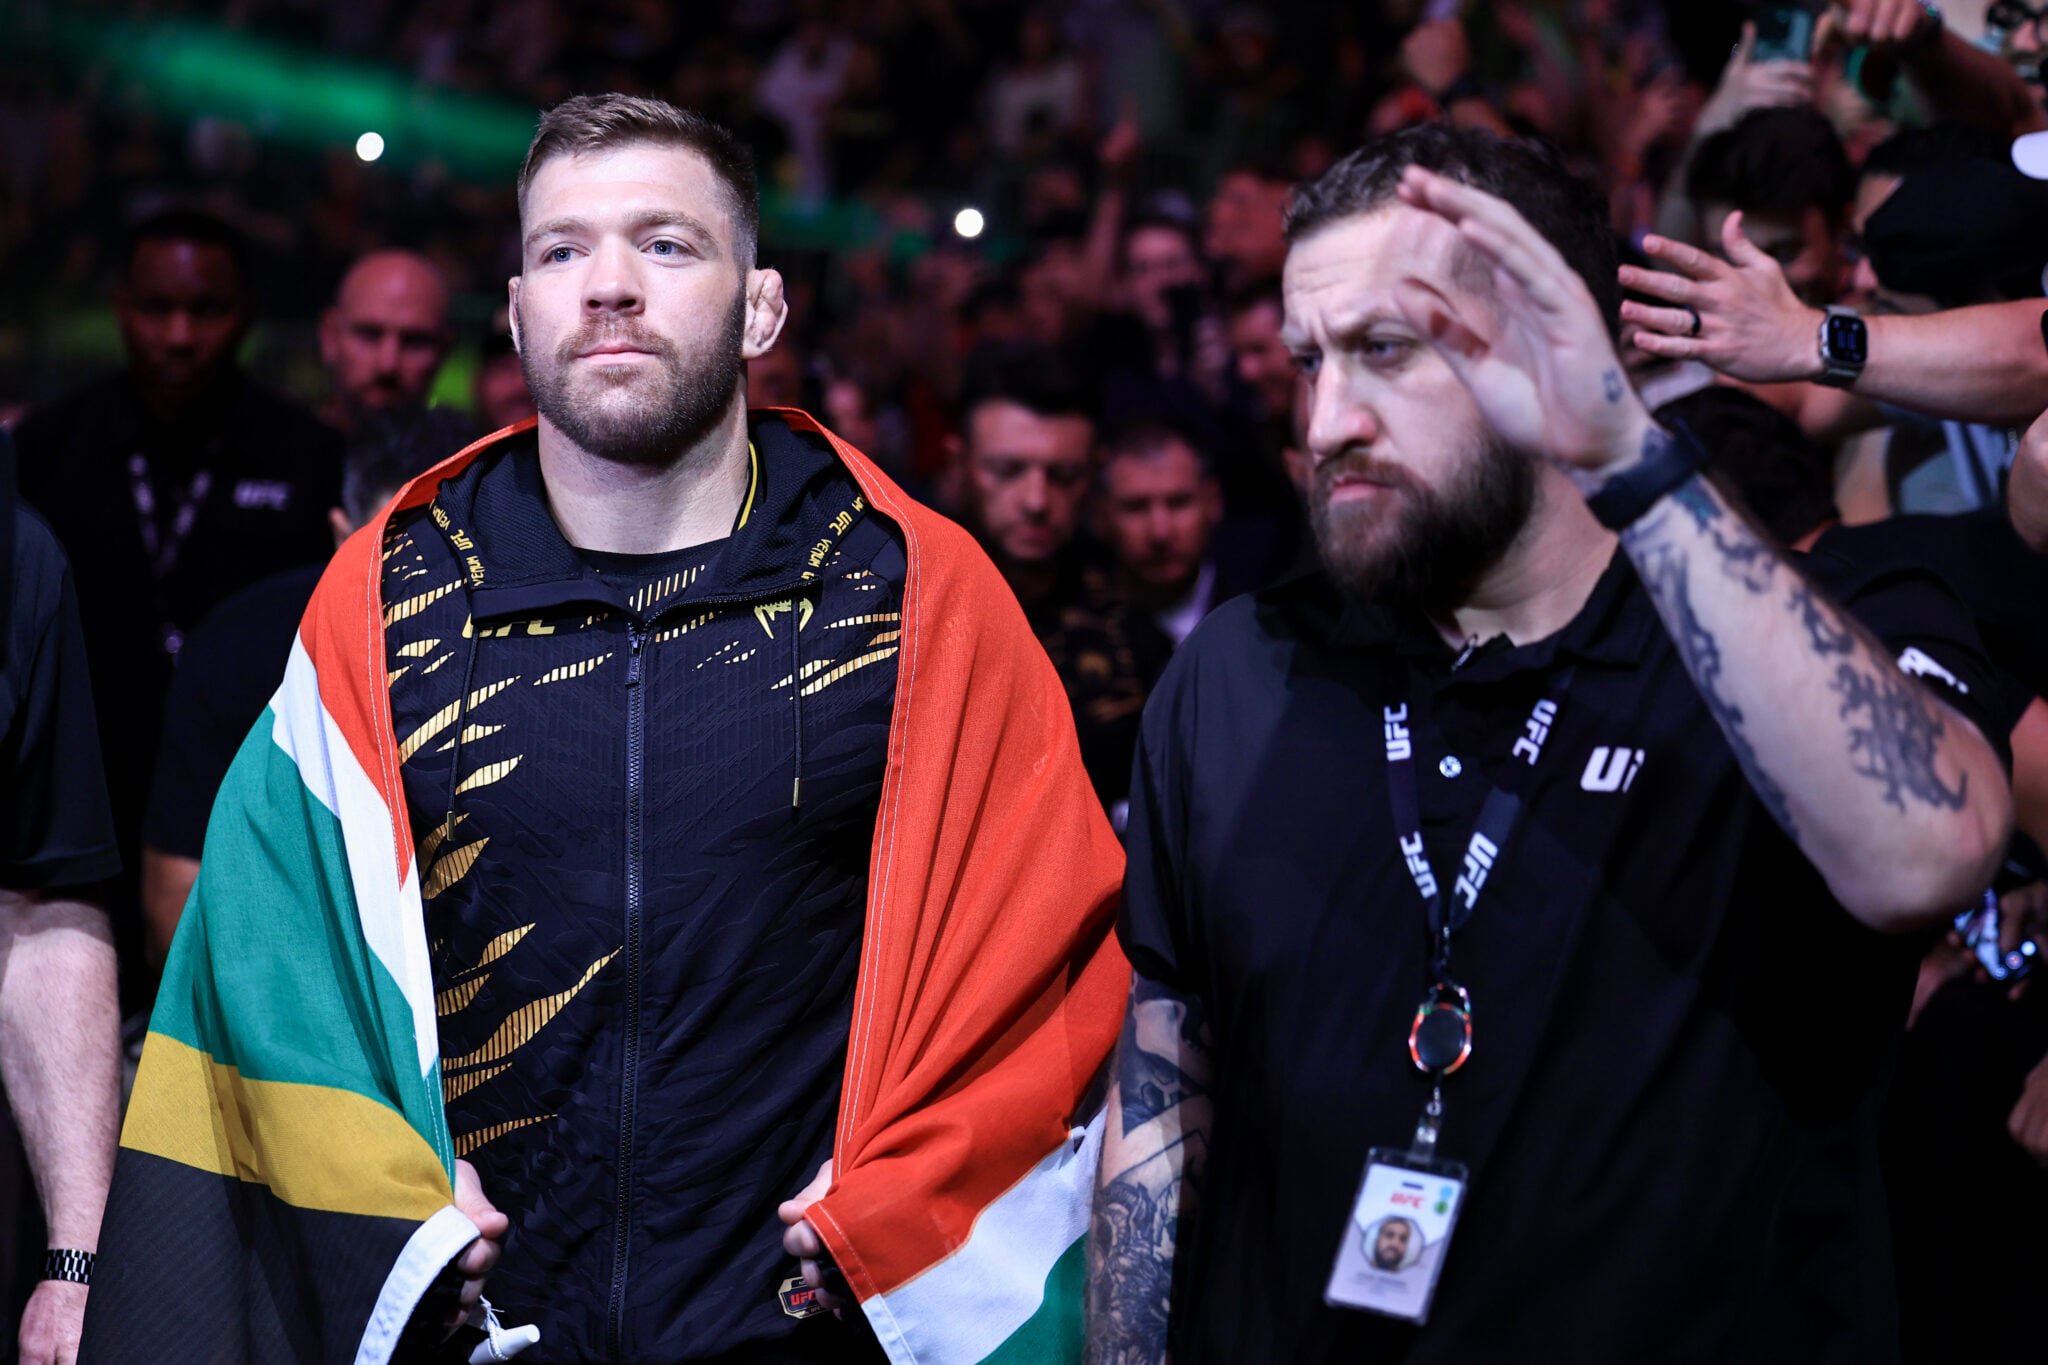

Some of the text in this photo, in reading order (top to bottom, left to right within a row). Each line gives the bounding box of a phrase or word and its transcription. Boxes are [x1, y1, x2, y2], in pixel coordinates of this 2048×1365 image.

[450, 528, 474, 551] UFC
[828, 510, 853, 537] UFC
[466, 555, 485, 587] VENUM
[807, 538, 833, 568] VENUM
[1384, 702, 1411, 762] UFC
[1512, 698, 1557, 766] UFC
[1400, 831, 1438, 899] UFC
[1455, 832, 1498, 910] UFC
